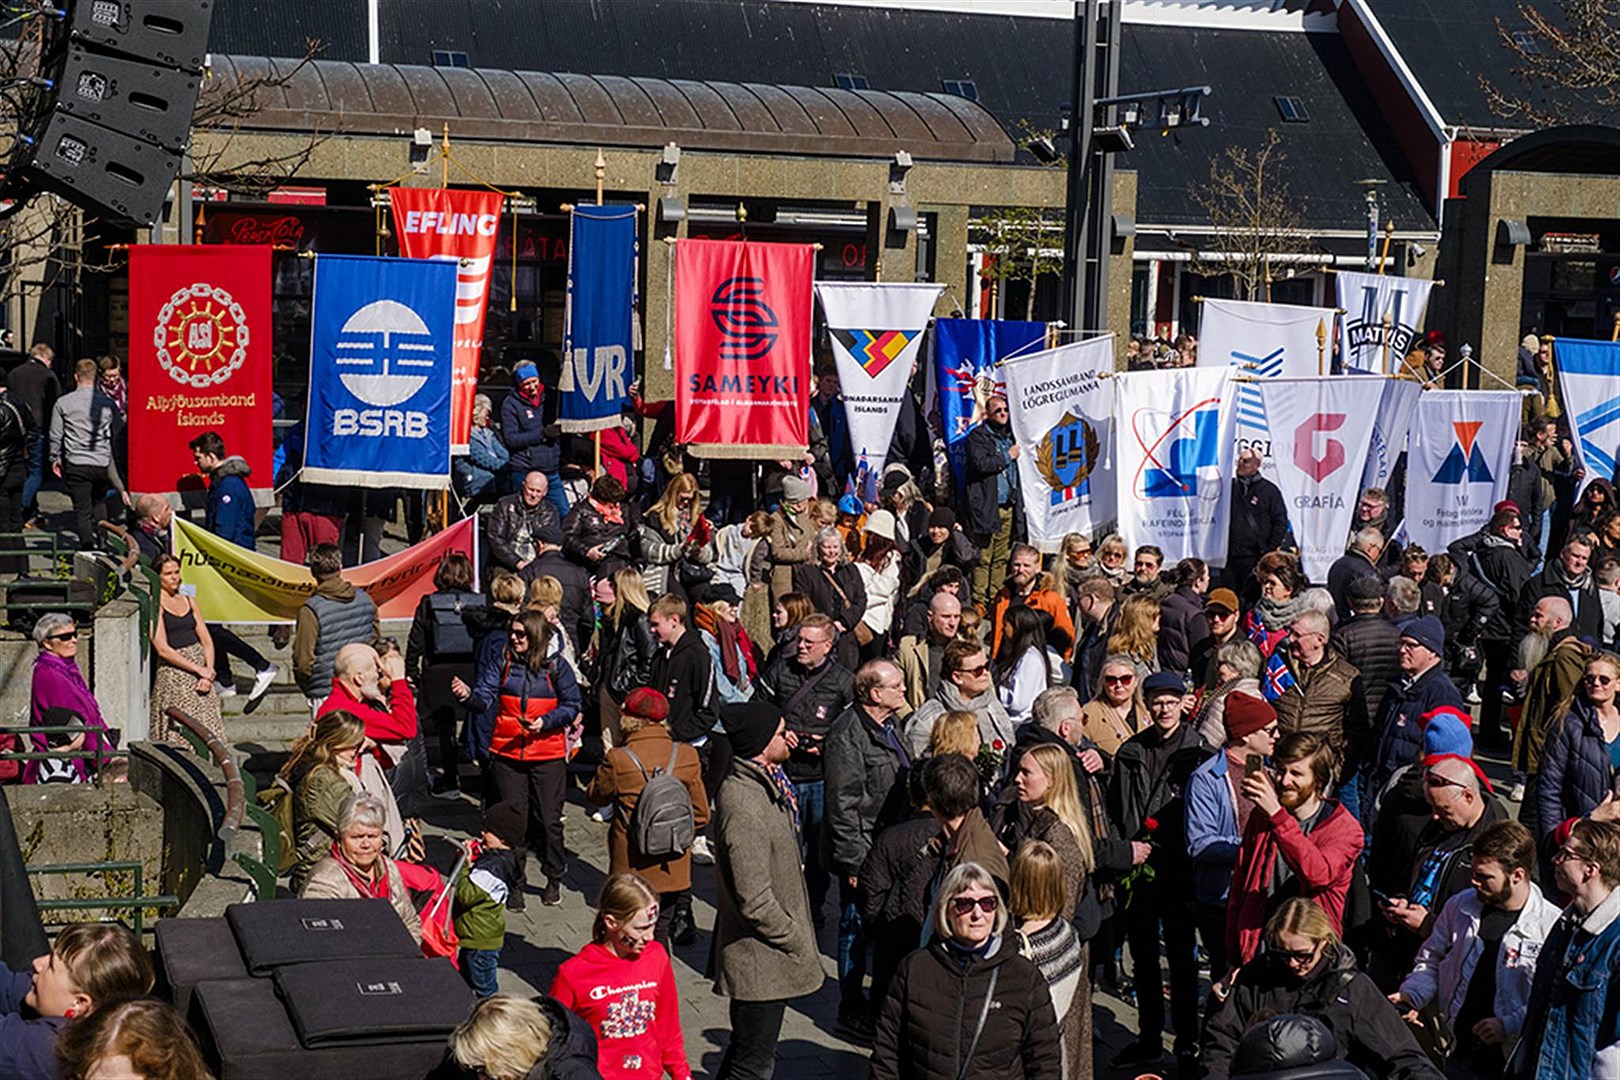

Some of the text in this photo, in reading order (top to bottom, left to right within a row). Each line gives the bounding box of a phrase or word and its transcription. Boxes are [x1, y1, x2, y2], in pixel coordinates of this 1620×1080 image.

[406, 210, 498, 237] EFLING
[574, 344, 626, 403] VR
[689, 373, 798, 394] SAMEYKI
[146, 393, 256, 413] Alþýðusamband
[176, 410, 226, 427] Íslands
[333, 408, 429, 438] BSRB
[1293, 492, 1346, 509] GRAFÍA
